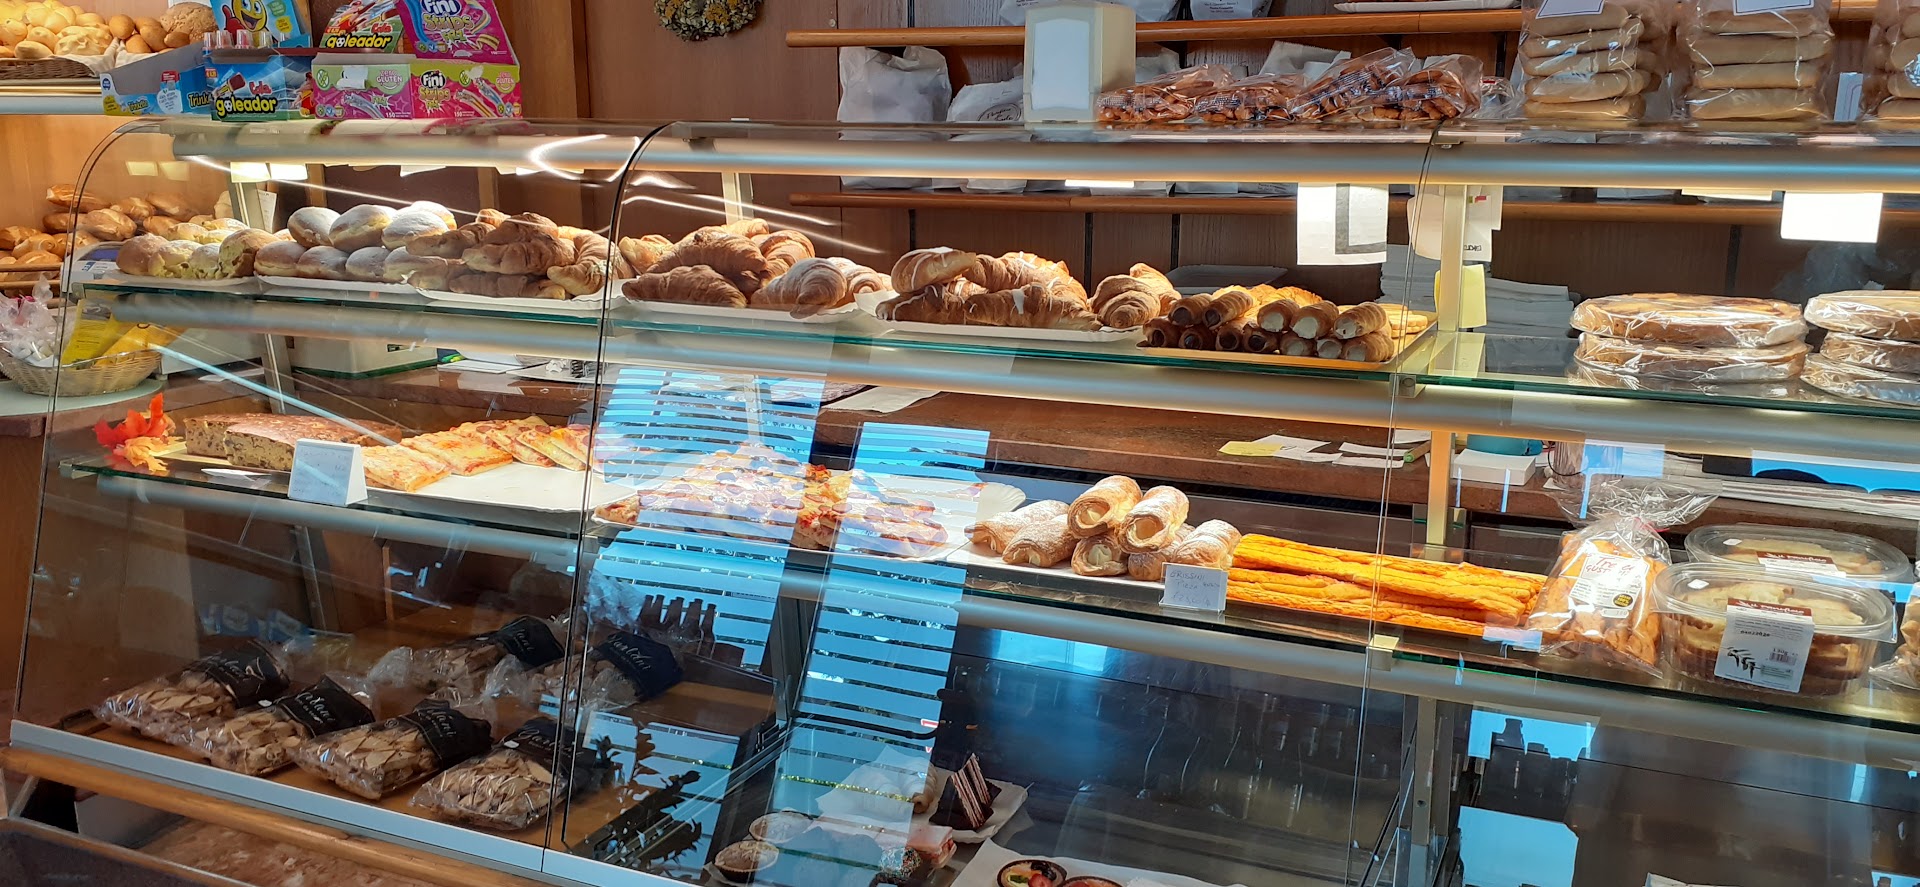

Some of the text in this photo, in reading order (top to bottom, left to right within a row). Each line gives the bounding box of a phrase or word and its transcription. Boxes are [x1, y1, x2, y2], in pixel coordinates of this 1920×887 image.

[326, 35, 391, 49] goleador
[423, 72, 444, 88] Fini
[216, 98, 277, 116] goleador
